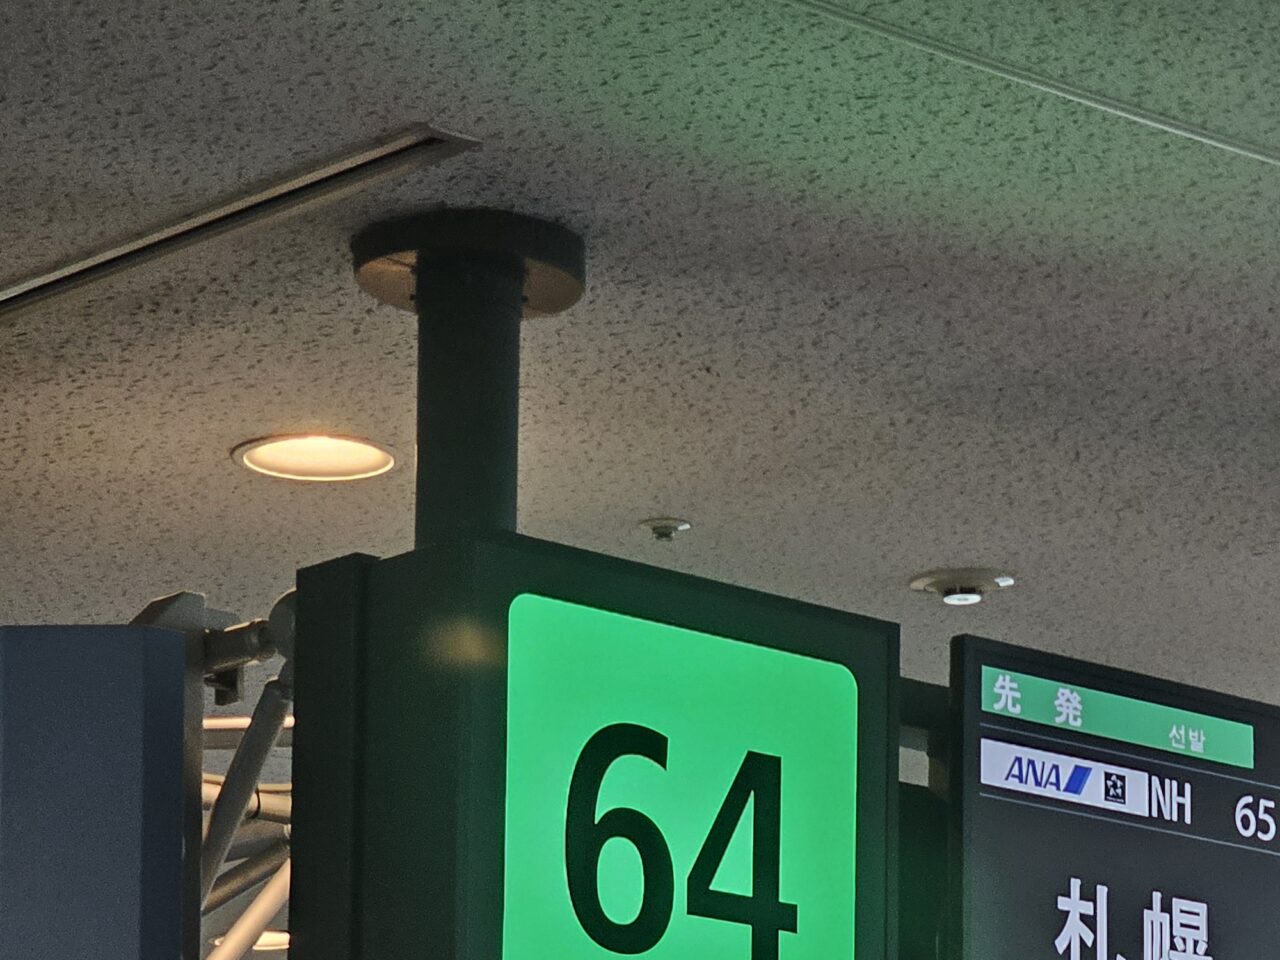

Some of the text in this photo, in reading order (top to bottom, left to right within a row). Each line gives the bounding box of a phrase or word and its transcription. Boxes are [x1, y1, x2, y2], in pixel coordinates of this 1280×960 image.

[1168, 723, 1206, 754] 선발
[1004, 755, 1277, 842] ANA NH 65
